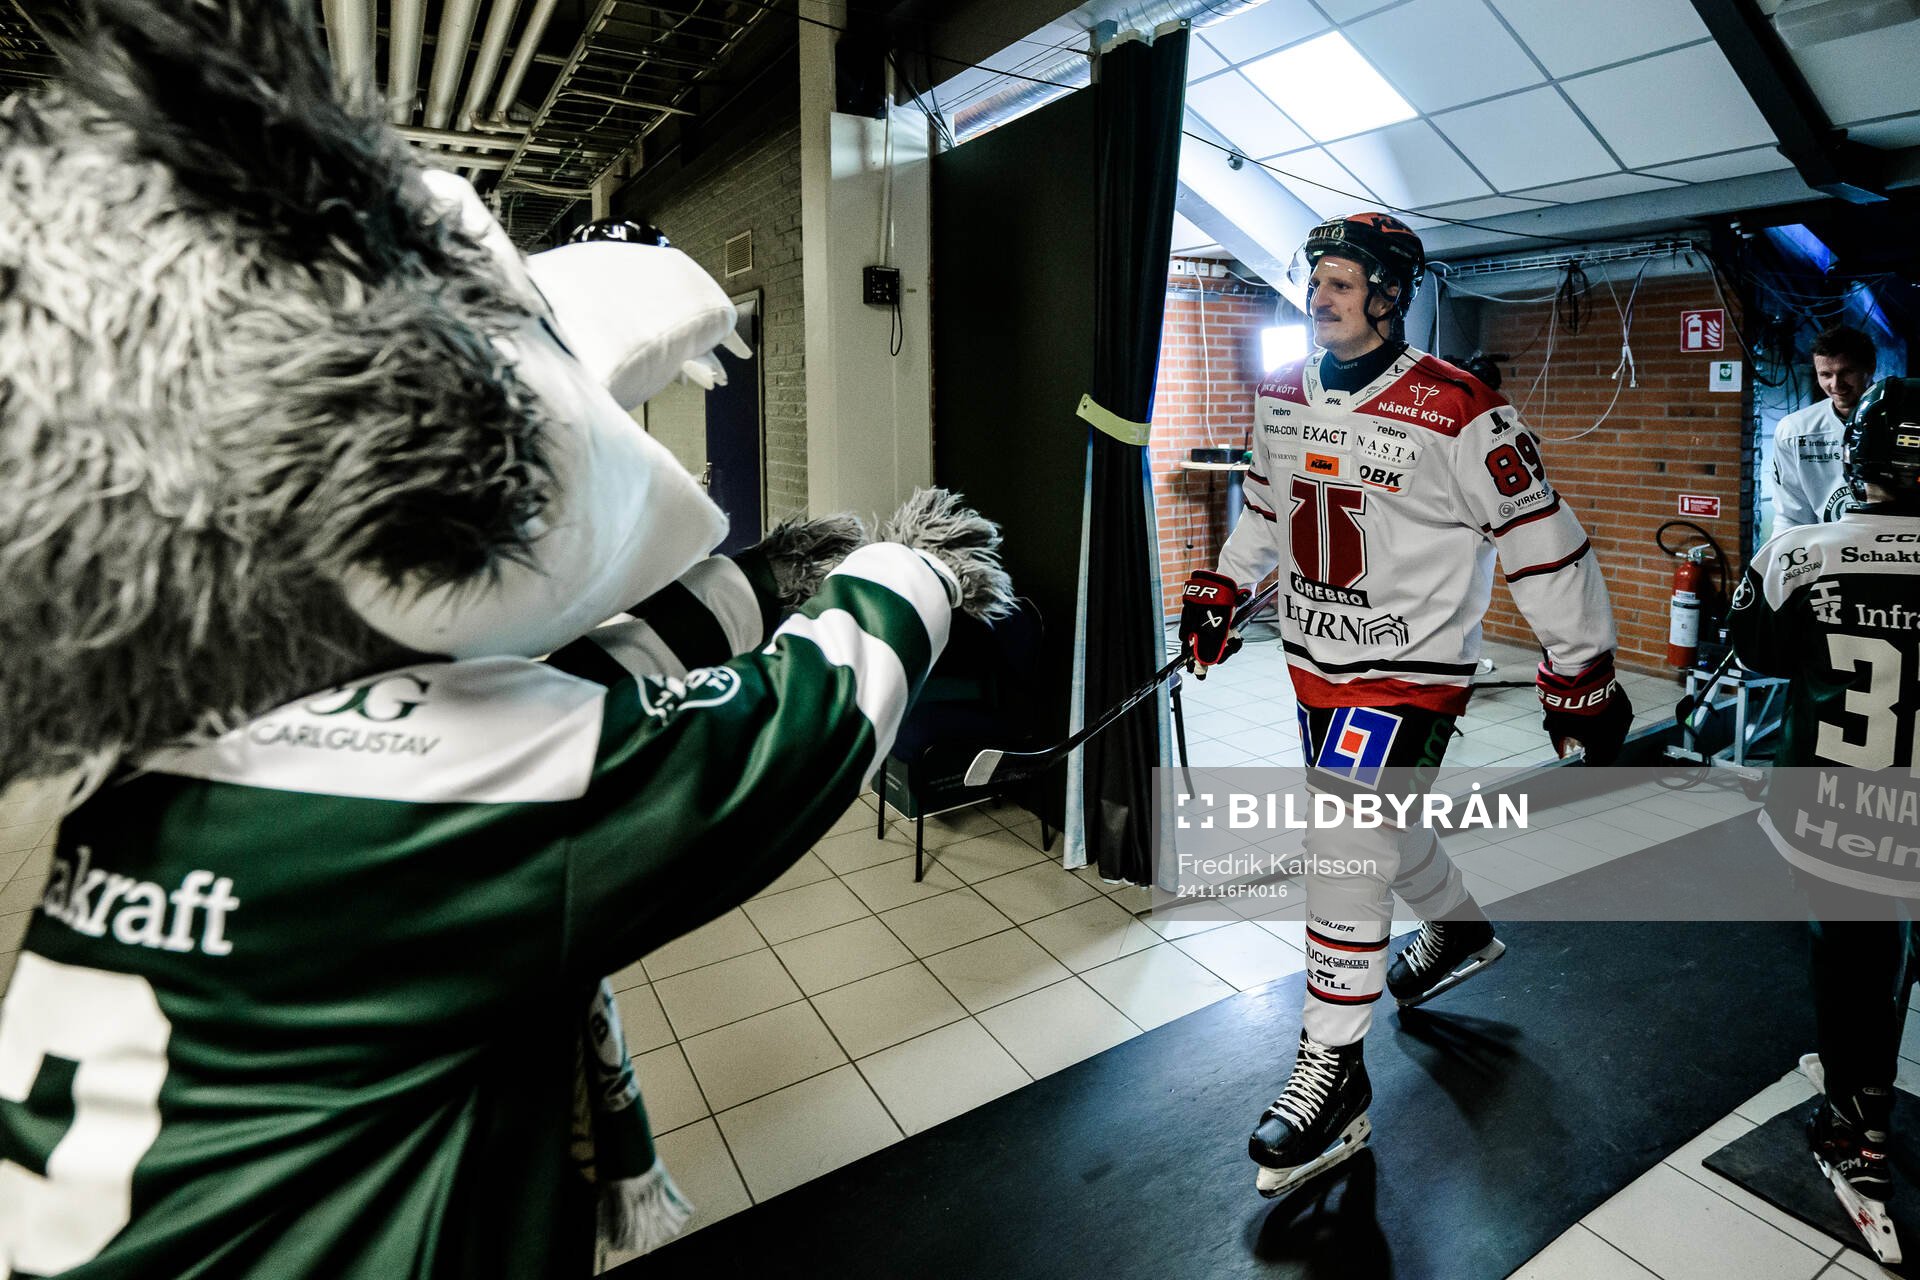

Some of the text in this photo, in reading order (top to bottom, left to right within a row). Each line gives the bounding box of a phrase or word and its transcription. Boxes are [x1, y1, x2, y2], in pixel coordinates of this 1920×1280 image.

[1325, 397, 1342, 406] SHL
[1377, 402, 1455, 428] NÄRKE KÖTT
[1303, 426, 1347, 446] EXACT
[1357, 435, 1416, 461] NASTA
[1311, 458, 1333, 471] KTM
[1484, 431, 1546, 498] 89
[1360, 465, 1404, 487] OBK
[1875, 534, 1920, 543] CC
[1294, 576, 1364, 606] ÖREBRO
[1307, 969, 1351, 990] STILL
